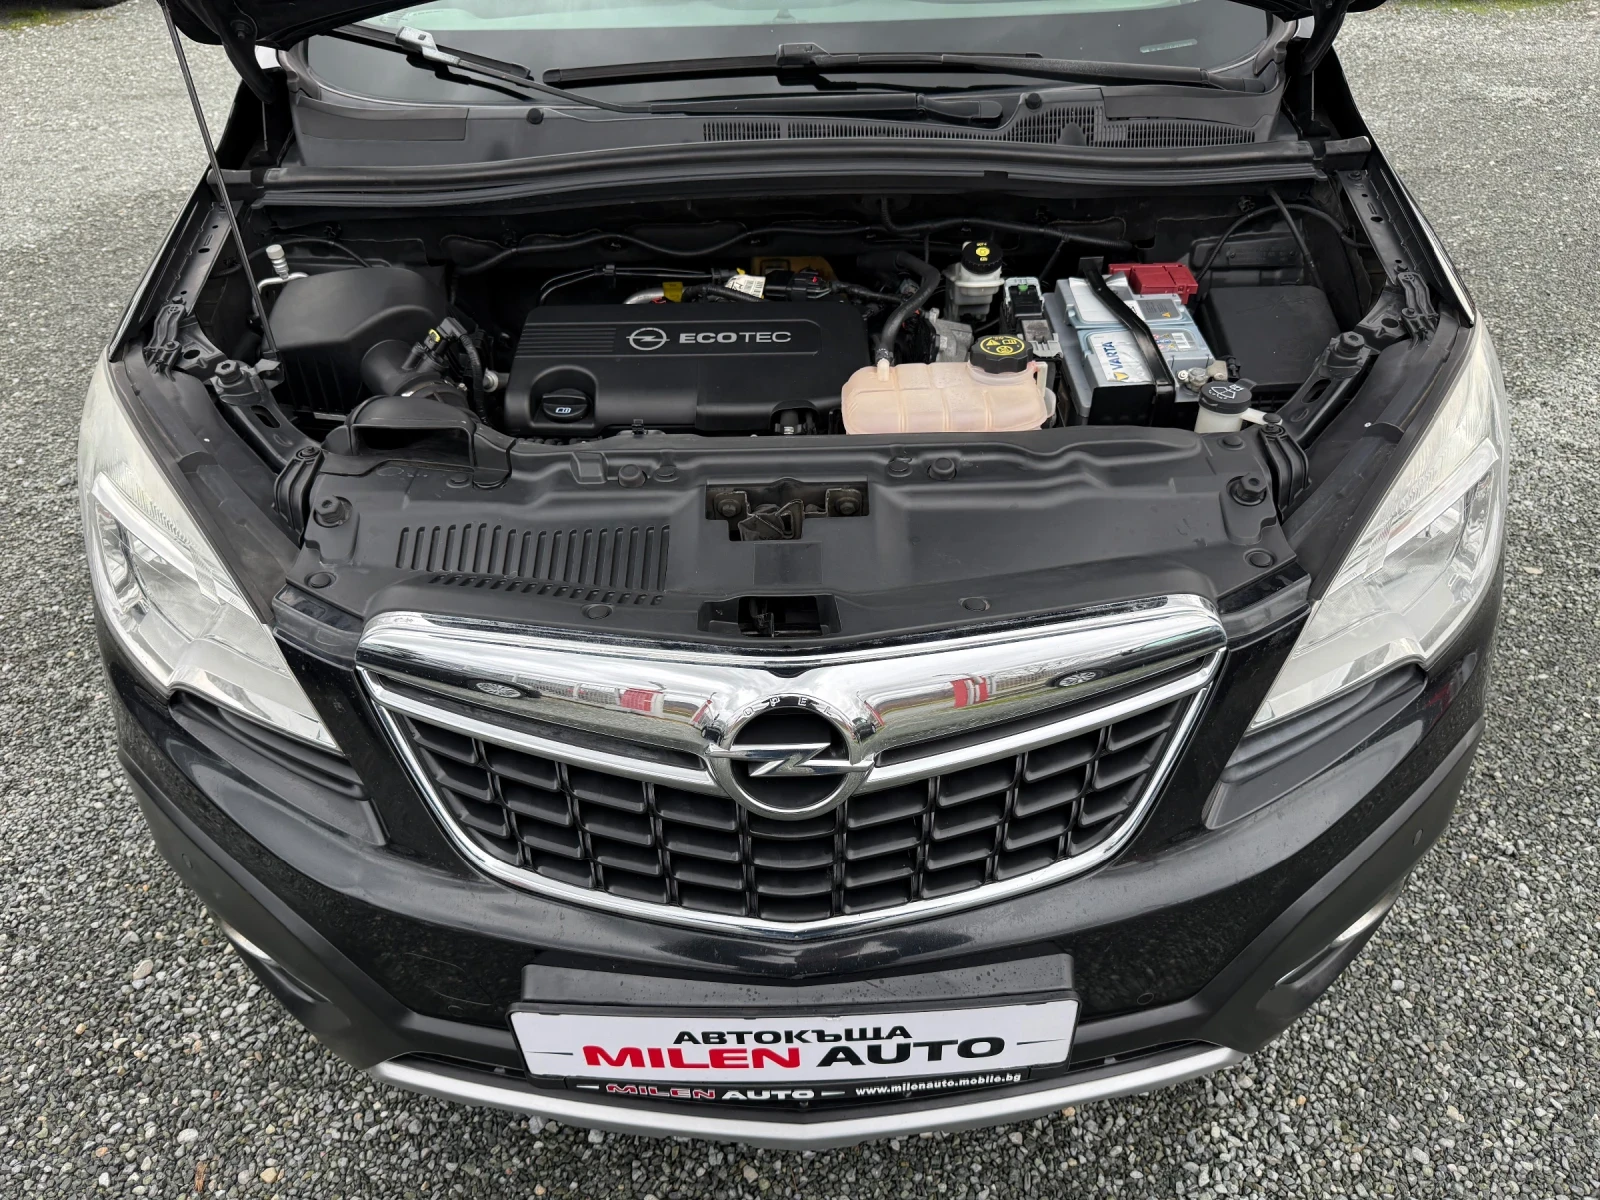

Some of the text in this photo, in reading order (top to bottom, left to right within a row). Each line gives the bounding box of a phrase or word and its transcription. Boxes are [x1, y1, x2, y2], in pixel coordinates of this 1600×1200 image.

[679, 331, 792, 344] ECOTEC
[1101, 341, 1124, 371] VARTA
[742, 696, 832, 717] OPEL
[582, 1036, 1006, 1069] MILEN AUTO
[605, 1072, 1022, 1101] MILEN AUTO www.milenauto.mobile.bg
